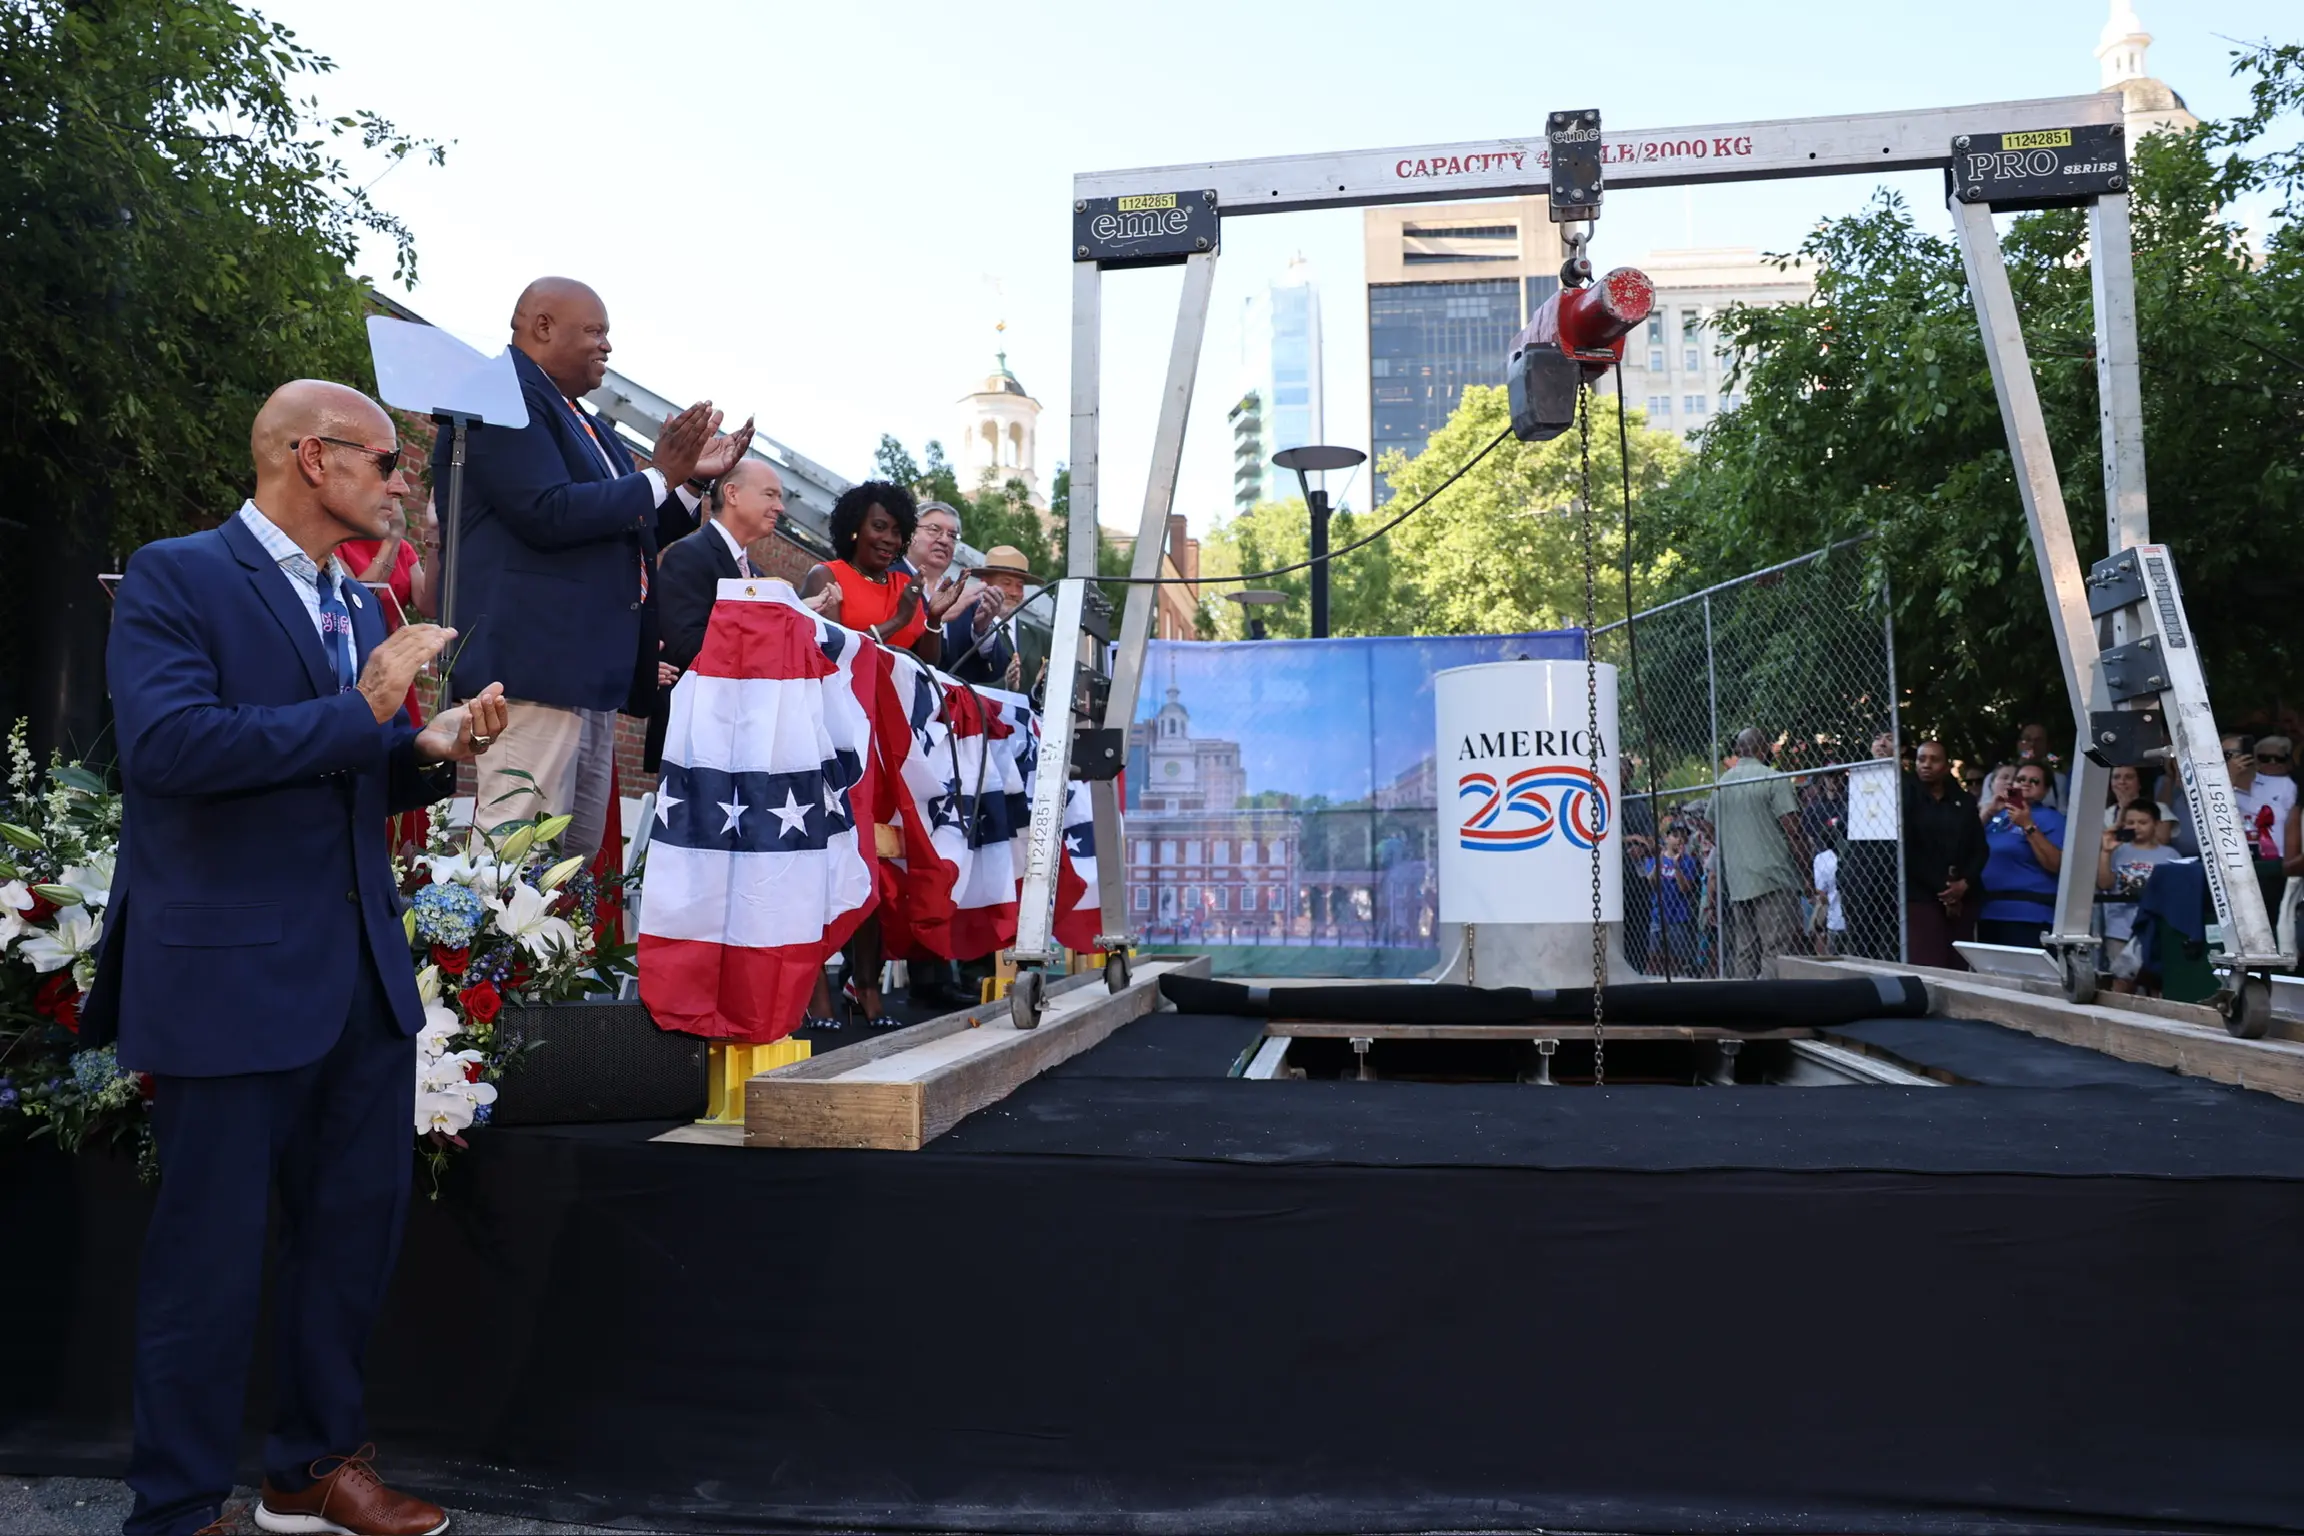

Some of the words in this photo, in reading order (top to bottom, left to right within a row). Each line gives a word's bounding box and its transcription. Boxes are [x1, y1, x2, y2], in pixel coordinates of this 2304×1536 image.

[1396, 151, 1525, 178] CAPACITY
[1713, 136, 1752, 156] KG
[2005, 131, 2068, 147] 11242851
[1967, 149, 2058, 181] PRO
[2063, 162, 2117, 175] SERIES
[1122, 196, 1175, 209] 11242851
[1091, 207, 1188, 240] eme
[1459, 730, 1607, 760] AMERICA
[1459, 765, 1611, 852] 250
[2207, 783, 2243, 870] 11242851
[1029, 797, 1051, 877] 11242851
[2189, 788, 2210, 847] United
[2205, 851, 2226, 918] Rentals
